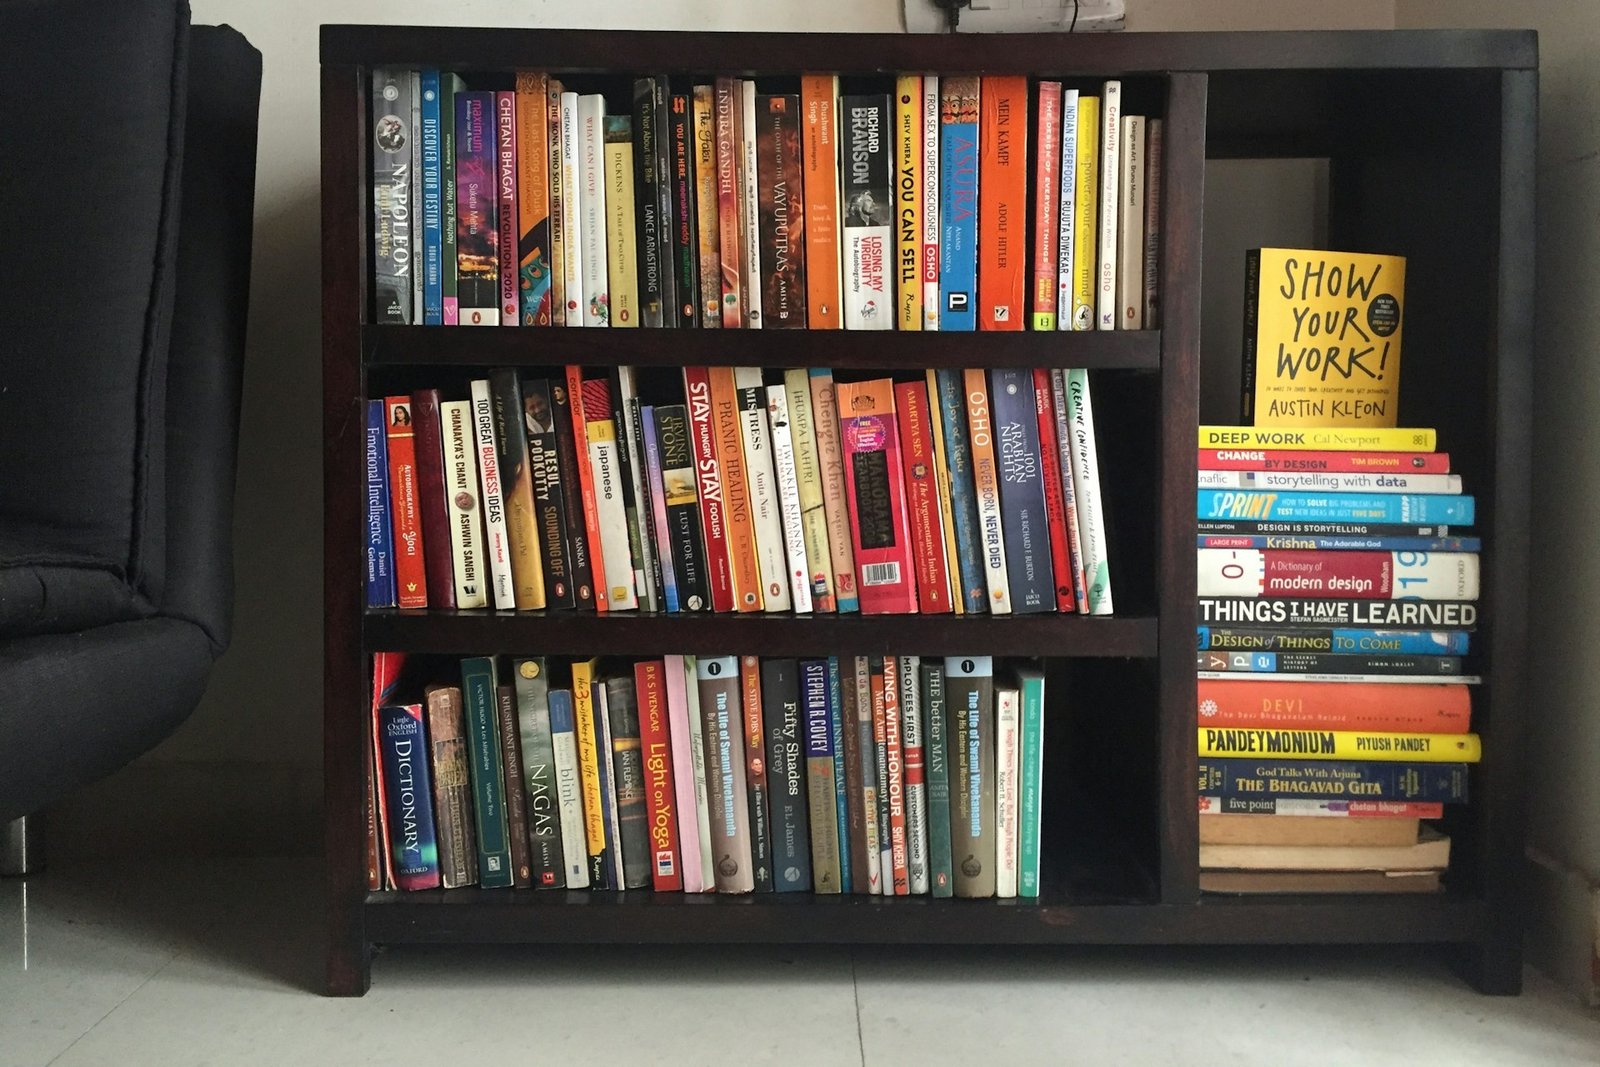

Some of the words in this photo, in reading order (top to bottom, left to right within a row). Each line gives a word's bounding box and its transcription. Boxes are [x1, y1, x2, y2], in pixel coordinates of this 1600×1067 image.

[501, 98, 511, 147] CHETAN
[718, 90, 729, 136] INDIRA
[820, 101, 829, 144] Khushwant
[999, 99, 1009, 126] MEIN
[1065, 106, 1075, 134] INDIAN
[424, 119, 435, 161] DISCOVER
[867, 107, 878, 152] RICHARD
[1107, 107, 1117, 151] Creativity
[851, 107, 869, 184] BRANSON
[999, 131, 1009, 166] KAMPF
[425, 166, 436, 190] YOUR
[502, 152, 513, 201] BHAGAT
[721, 141, 731, 194] GANDHI
[1063, 137, 1073, 193] SUPERFOODS
[469, 184, 477, 209] Suketu
[902, 167, 913, 202] YOU
[392, 164, 409, 277] NAPOLEON
[426, 194, 437, 229] DESTINY
[469, 211, 477, 234] Mehta
[645, 204, 655, 233] LANCE
[774, 182, 788, 272] VAYUPUTRAS
[902, 209, 914, 242] CAN
[999, 202, 1007, 232] ADOLF
[1062, 201, 1071, 233] RUJUTA
[502, 204, 511, 269] REVOLUTION
[999, 237, 1007, 268] HITLER
[646, 236, 657, 292] ARMSTRONG
[861, 237, 871, 286] VIRGINITY
[872, 236, 881, 272] LOSING
[902, 249, 914, 283] SELL
[926, 247, 935, 279] OSHO
[1061, 236, 1070, 273] DIWEKAR
[429, 264, 437, 285] SHARMA
[504, 273, 513, 299] 2020
[873, 276, 882, 292] MY
[1280, 258, 1382, 301] SHOW
[779, 280, 787, 309] AMISH
[1293, 307, 1371, 342] YOUR
[1277, 341, 1390, 381] WORK!
[477, 399, 488, 414] 100
[690, 382, 709, 423] STAY
[1269, 399, 1324, 417] AUSTIN
[1331, 400, 1385, 419] KLEON
[451, 409, 464, 459] CHANAKYA'S
[479, 416, 492, 445] GREAT
[719, 402, 736, 454] PRANIC
[746, 388, 762, 451] MISTRESS
[970, 392, 989, 447] OSHO
[660, 416, 677, 466] STONE
[700, 424, 712, 458] HUNGRY
[1000, 425, 1015, 482] NIGHTS
[1010, 422, 1026, 483] ARABIAN
[1210, 433, 1250, 444] DEEP
[1256, 433, 1304, 444] WORK
[1313, 435, 1331, 444] Cal
[1334, 435, 1381, 446] Newport
[456, 462, 467, 488] CHANT
[483, 447, 498, 494] BUSINESS
[531, 439, 549, 500] POOKUTTY
[544, 450, 559, 488] RESUL
[597, 445, 613, 500] japanese
[1217, 451, 1265, 461] CHANGE
[1265, 459, 1281, 469] BY
[1284, 460, 1327, 469] DESIGN
[1369, 458, 1400, 466] BROWN
[699, 459, 721, 502] STAY
[726, 460, 746, 523] HEALING
[1199, 474, 1228, 483] naflic
[1267, 475, 1339, 489] storytelling
[1344, 476, 1370, 487] with
[1376, 477, 1407, 487] data
[487, 495, 501, 523] IDEAS
[709, 503, 720, 538] FOOLISH
[1209, 493, 1278, 520] SPRINT
[460, 514, 471, 548] ASHWIN
[544, 506, 561, 557] SOUNDING
[678, 511, 688, 535] LUST
[1257, 523, 1290, 532] DESIGN
[1293, 524, 1302, 532] IS
[1304, 524, 1367, 534] STORYTELLING
[367, 547, 376, 582] Goleman
[377, 552, 386, 576] Daniel
[464, 550, 475, 581] SANGHI
[683, 540, 692, 559] FOR
[551, 559, 564, 577] OFF
[686, 563, 695, 583] LIFE
[1271, 561, 1277, 571] A
[1279, 561, 1314, 572] Dictionary
[1316, 561, 1322, 571] of
[1380, 561, 1389, 593] Woodham
[1270, 575, 1323, 589] modern
[1328, 575, 1372, 593] design
[1199, 600, 1286, 622] THINGS
[1290, 602, 1299, 616] I
[1303, 602, 1349, 617] HAVE
[1353, 603, 1476, 625] LEARNED
[716, 692, 727, 710] The
[957, 711, 967, 719] By
[968, 691, 979, 709] The
[1263, 698, 1303, 711] DEVI
[717, 711, 728, 729] Life
[772, 728, 783, 742] of
[782, 702, 797, 739] Fifty
[958, 720, 968, 730] His
[969, 710, 979, 728] Life
[969, 730, 980, 739] of
[719, 731, 729, 740] of
[959, 730, 968, 753] Eastern
[1207, 730, 1336, 754] PANDEYMONIUM
[1357, 737, 1391, 751] PIYUSH
[1394, 738, 1430, 751] PANDEY
[646, 743, 668, 788] Light
[720, 741, 732, 773] Swami
[772, 744, 784, 774] Grey
[785, 743, 800, 796] Shades
[960, 754, 968, 766] and
[970, 740, 980, 773] Swami
[559, 768, 576, 807] blink
[960, 767, 969, 792] Western
[1236, 779, 1264, 792] THE
[1269, 779, 1345, 793] BHAGAVAD
[1349, 781, 1382, 794] GITA
[395, 740, 419, 853] DICTIONARY
[529, 764, 553, 836] NAGAS
[653, 791, 663, 807] on
[722, 775, 737, 837] Vivekananda
[970, 775, 982, 837] Vivekananda
[1229, 798, 1247, 809] five
[1250, 799, 1273, 811] point
[652, 805, 673, 848] Yoga
[893, 827, 902, 844] SHIV
[894, 845, 904, 869] KHERA
